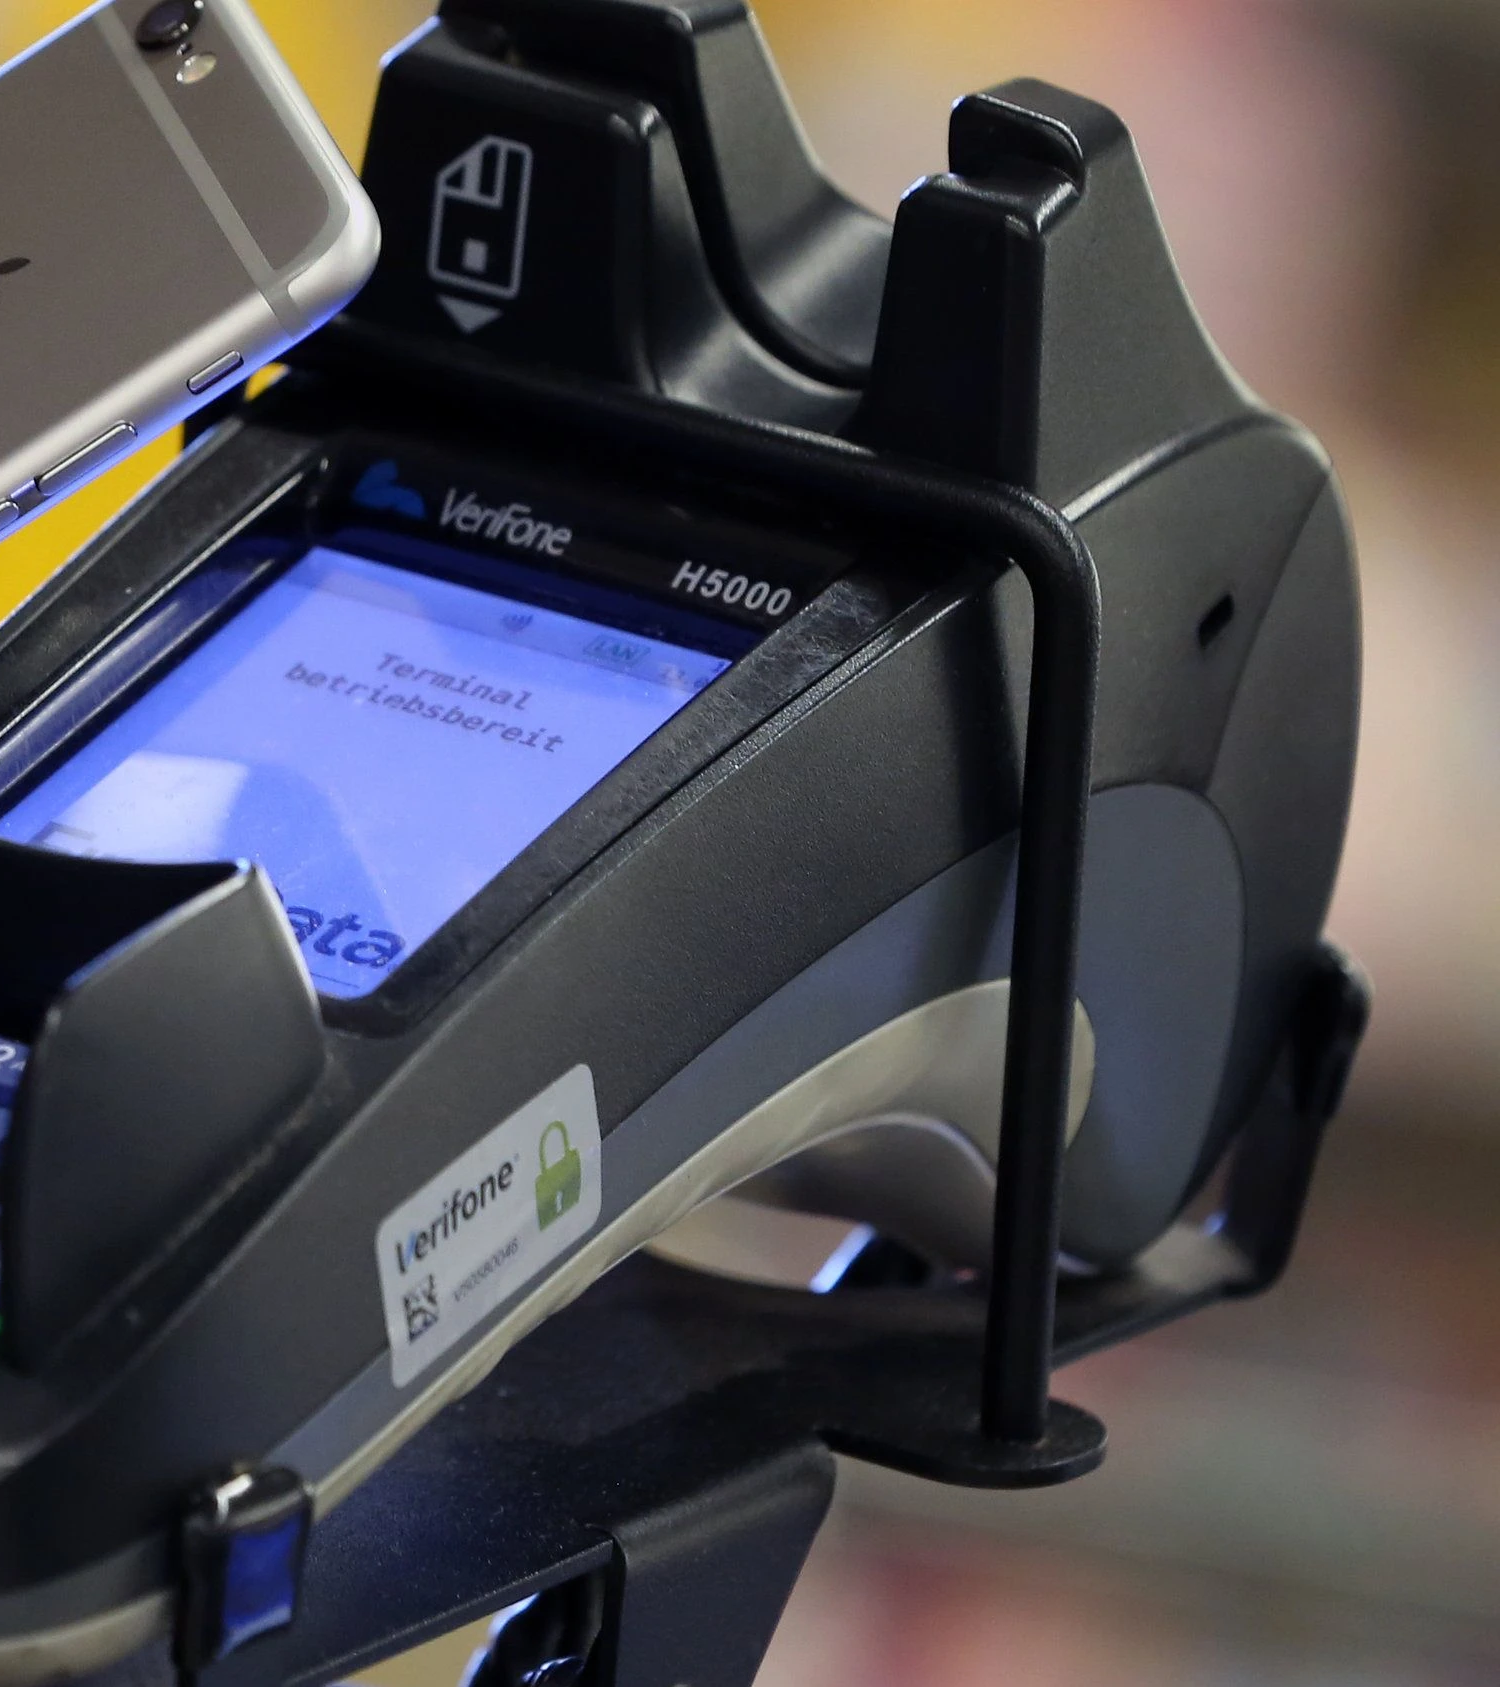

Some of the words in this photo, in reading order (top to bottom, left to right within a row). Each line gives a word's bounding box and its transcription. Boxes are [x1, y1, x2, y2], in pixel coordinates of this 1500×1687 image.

[438, 488, 574, 557] VeriFone
[670, 561, 793, 617] H5000
[285, 661, 564, 754] betriebsbereit
[377, 652, 532, 713] Terminal
[278, 892, 406, 968] ata
[395, 1159, 515, 1275] Verifone
